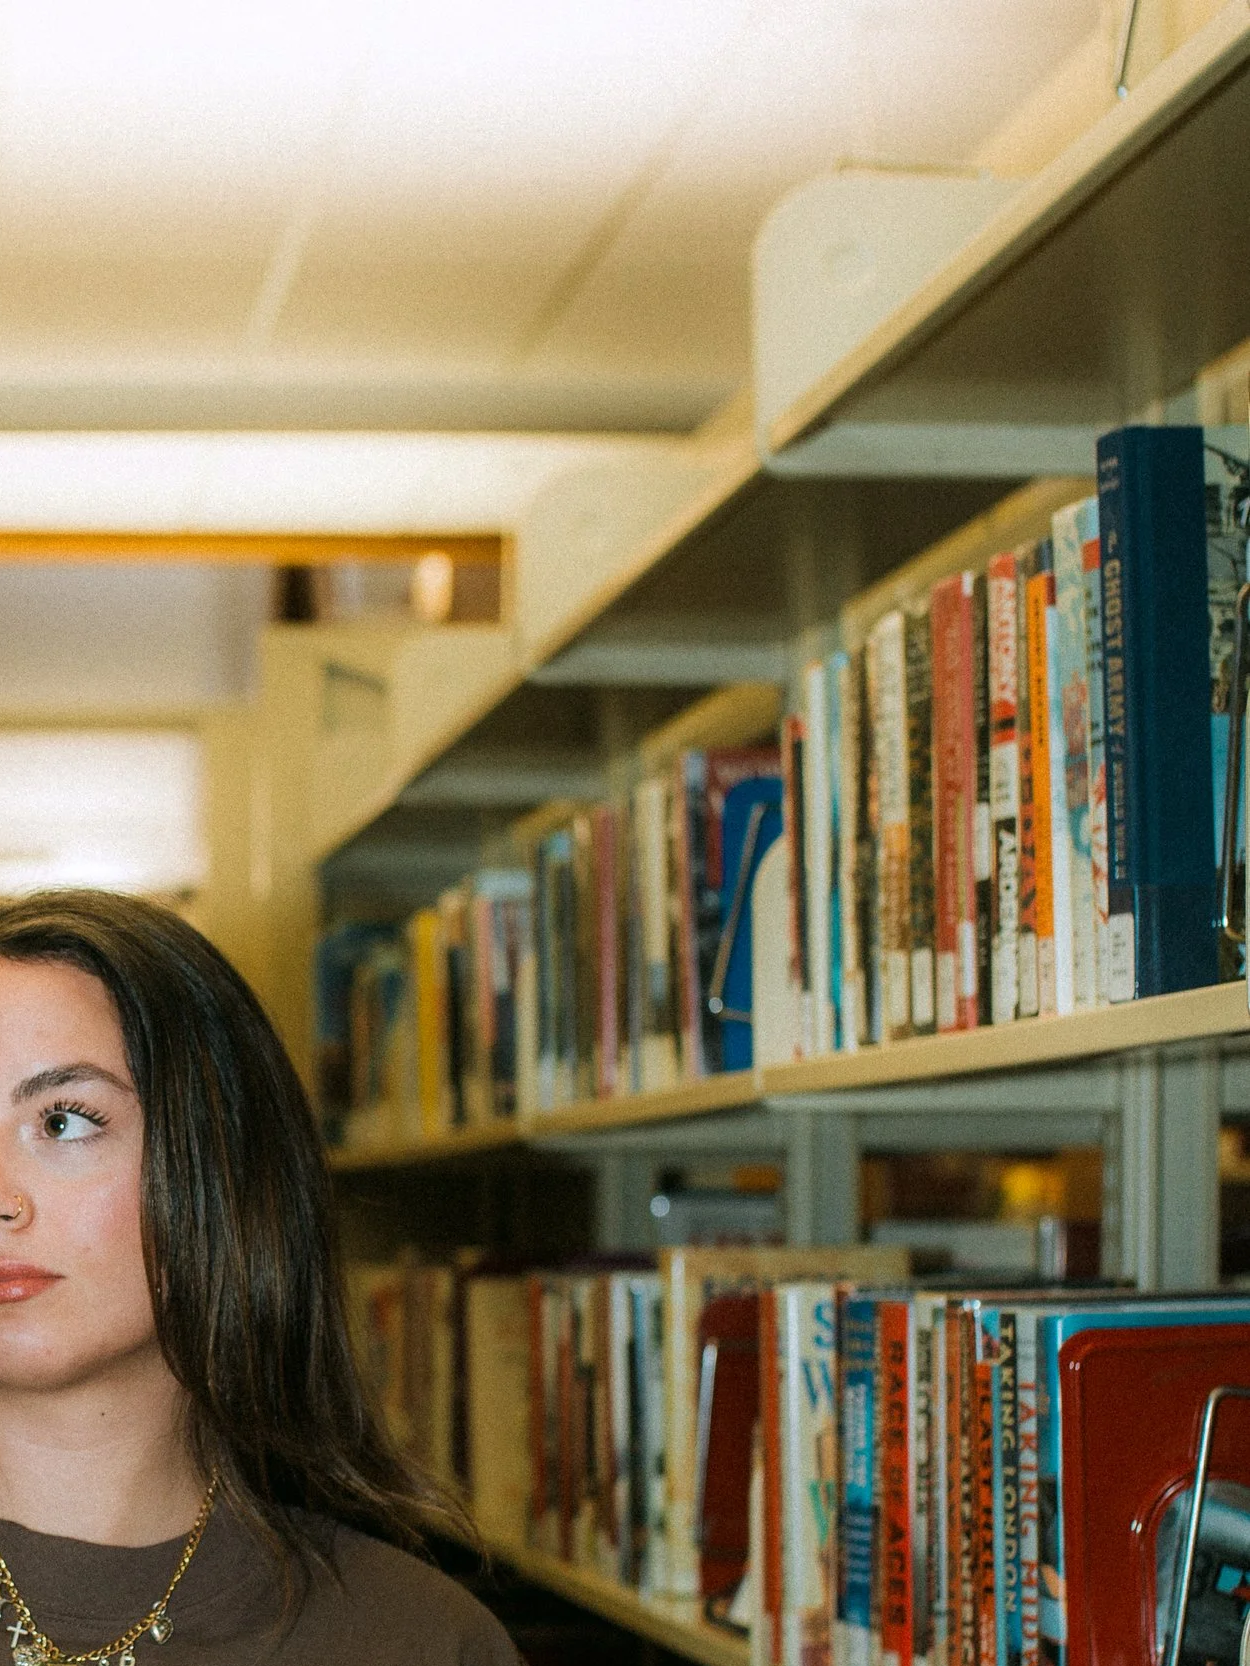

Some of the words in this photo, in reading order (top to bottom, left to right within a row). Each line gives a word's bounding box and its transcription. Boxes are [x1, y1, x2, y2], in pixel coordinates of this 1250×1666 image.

[998, 1323, 1016, 1449] TAKING
[1017, 1380, 1039, 1533] TAKING
[1002, 1467, 1017, 1614] LONDON
